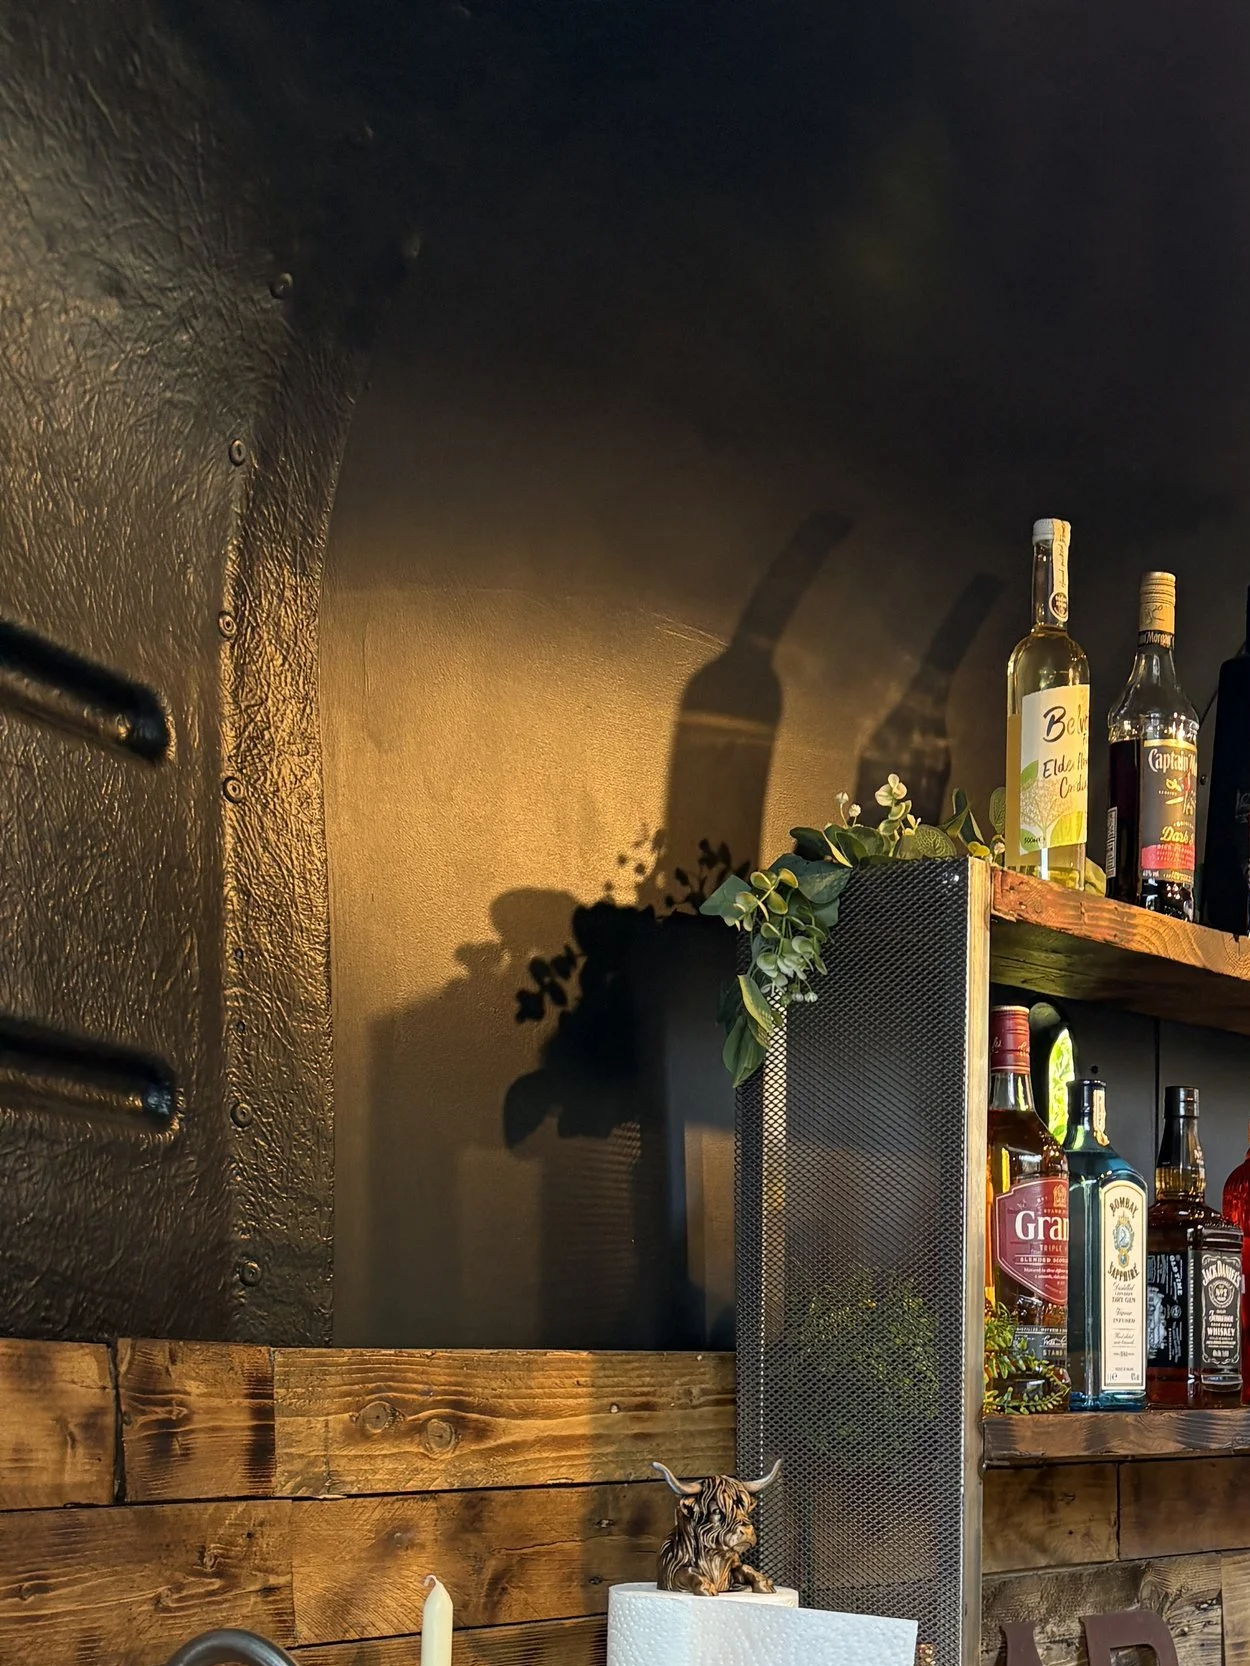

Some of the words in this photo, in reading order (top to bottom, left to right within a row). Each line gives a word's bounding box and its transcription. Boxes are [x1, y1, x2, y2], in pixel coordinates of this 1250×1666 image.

[1109, 1196, 1139, 1218] BOMBAY
[1108, 1261, 1140, 1282] SAPPHIRE
[1202, 1267, 1218, 1287] JACK
[1207, 1327, 1236, 1337] WHISKEY
